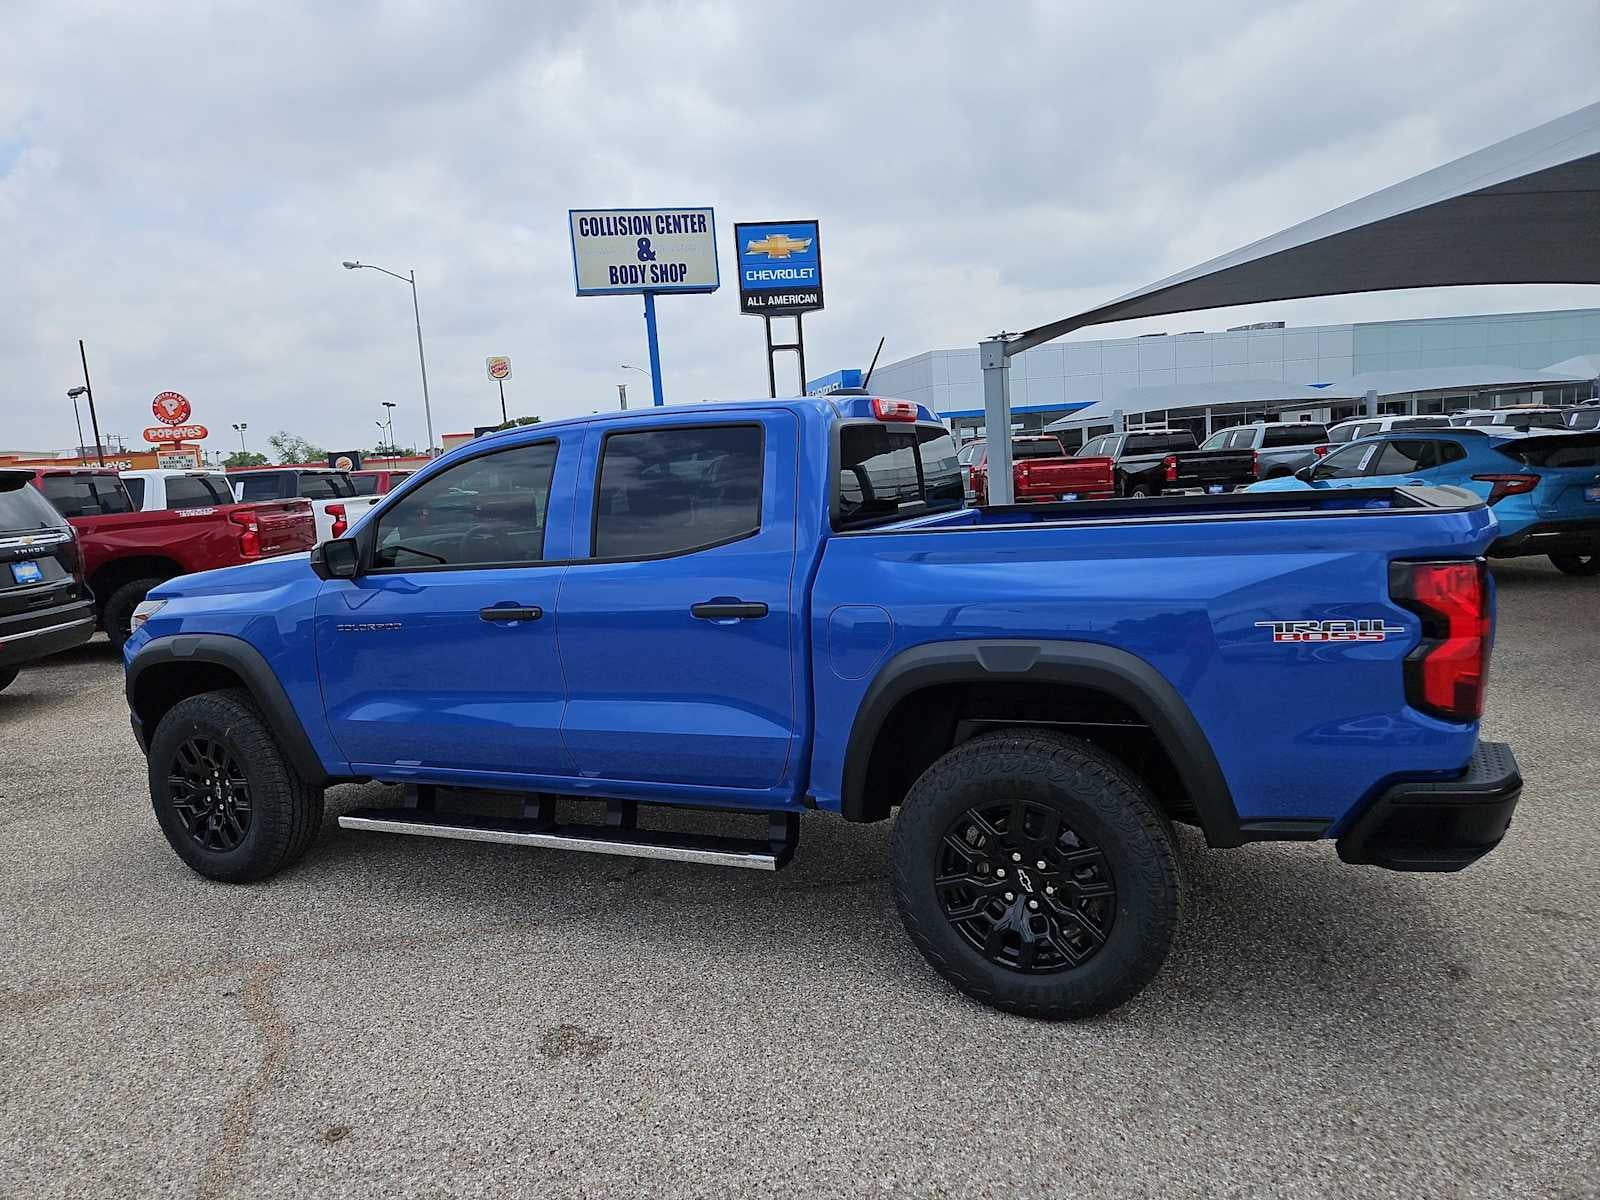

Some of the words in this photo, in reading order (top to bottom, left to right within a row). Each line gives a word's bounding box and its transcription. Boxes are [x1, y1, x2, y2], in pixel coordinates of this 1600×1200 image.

[579, 216, 651, 237] COLLISION
[655, 214, 707, 235] CENTER
[637, 237, 656, 262] &
[609, 265, 646, 285] BODY
[650, 263, 687, 283] SHOP
[746, 268, 814, 281] CHEVROLET
[747, 296, 765, 306] ALL
[768, 293, 817, 306] AMERICAN
[336, 622, 402, 632] COLORADO
[1254, 619, 1404, 632] TRAIL
[1273, 632, 1385, 642] BOSS
